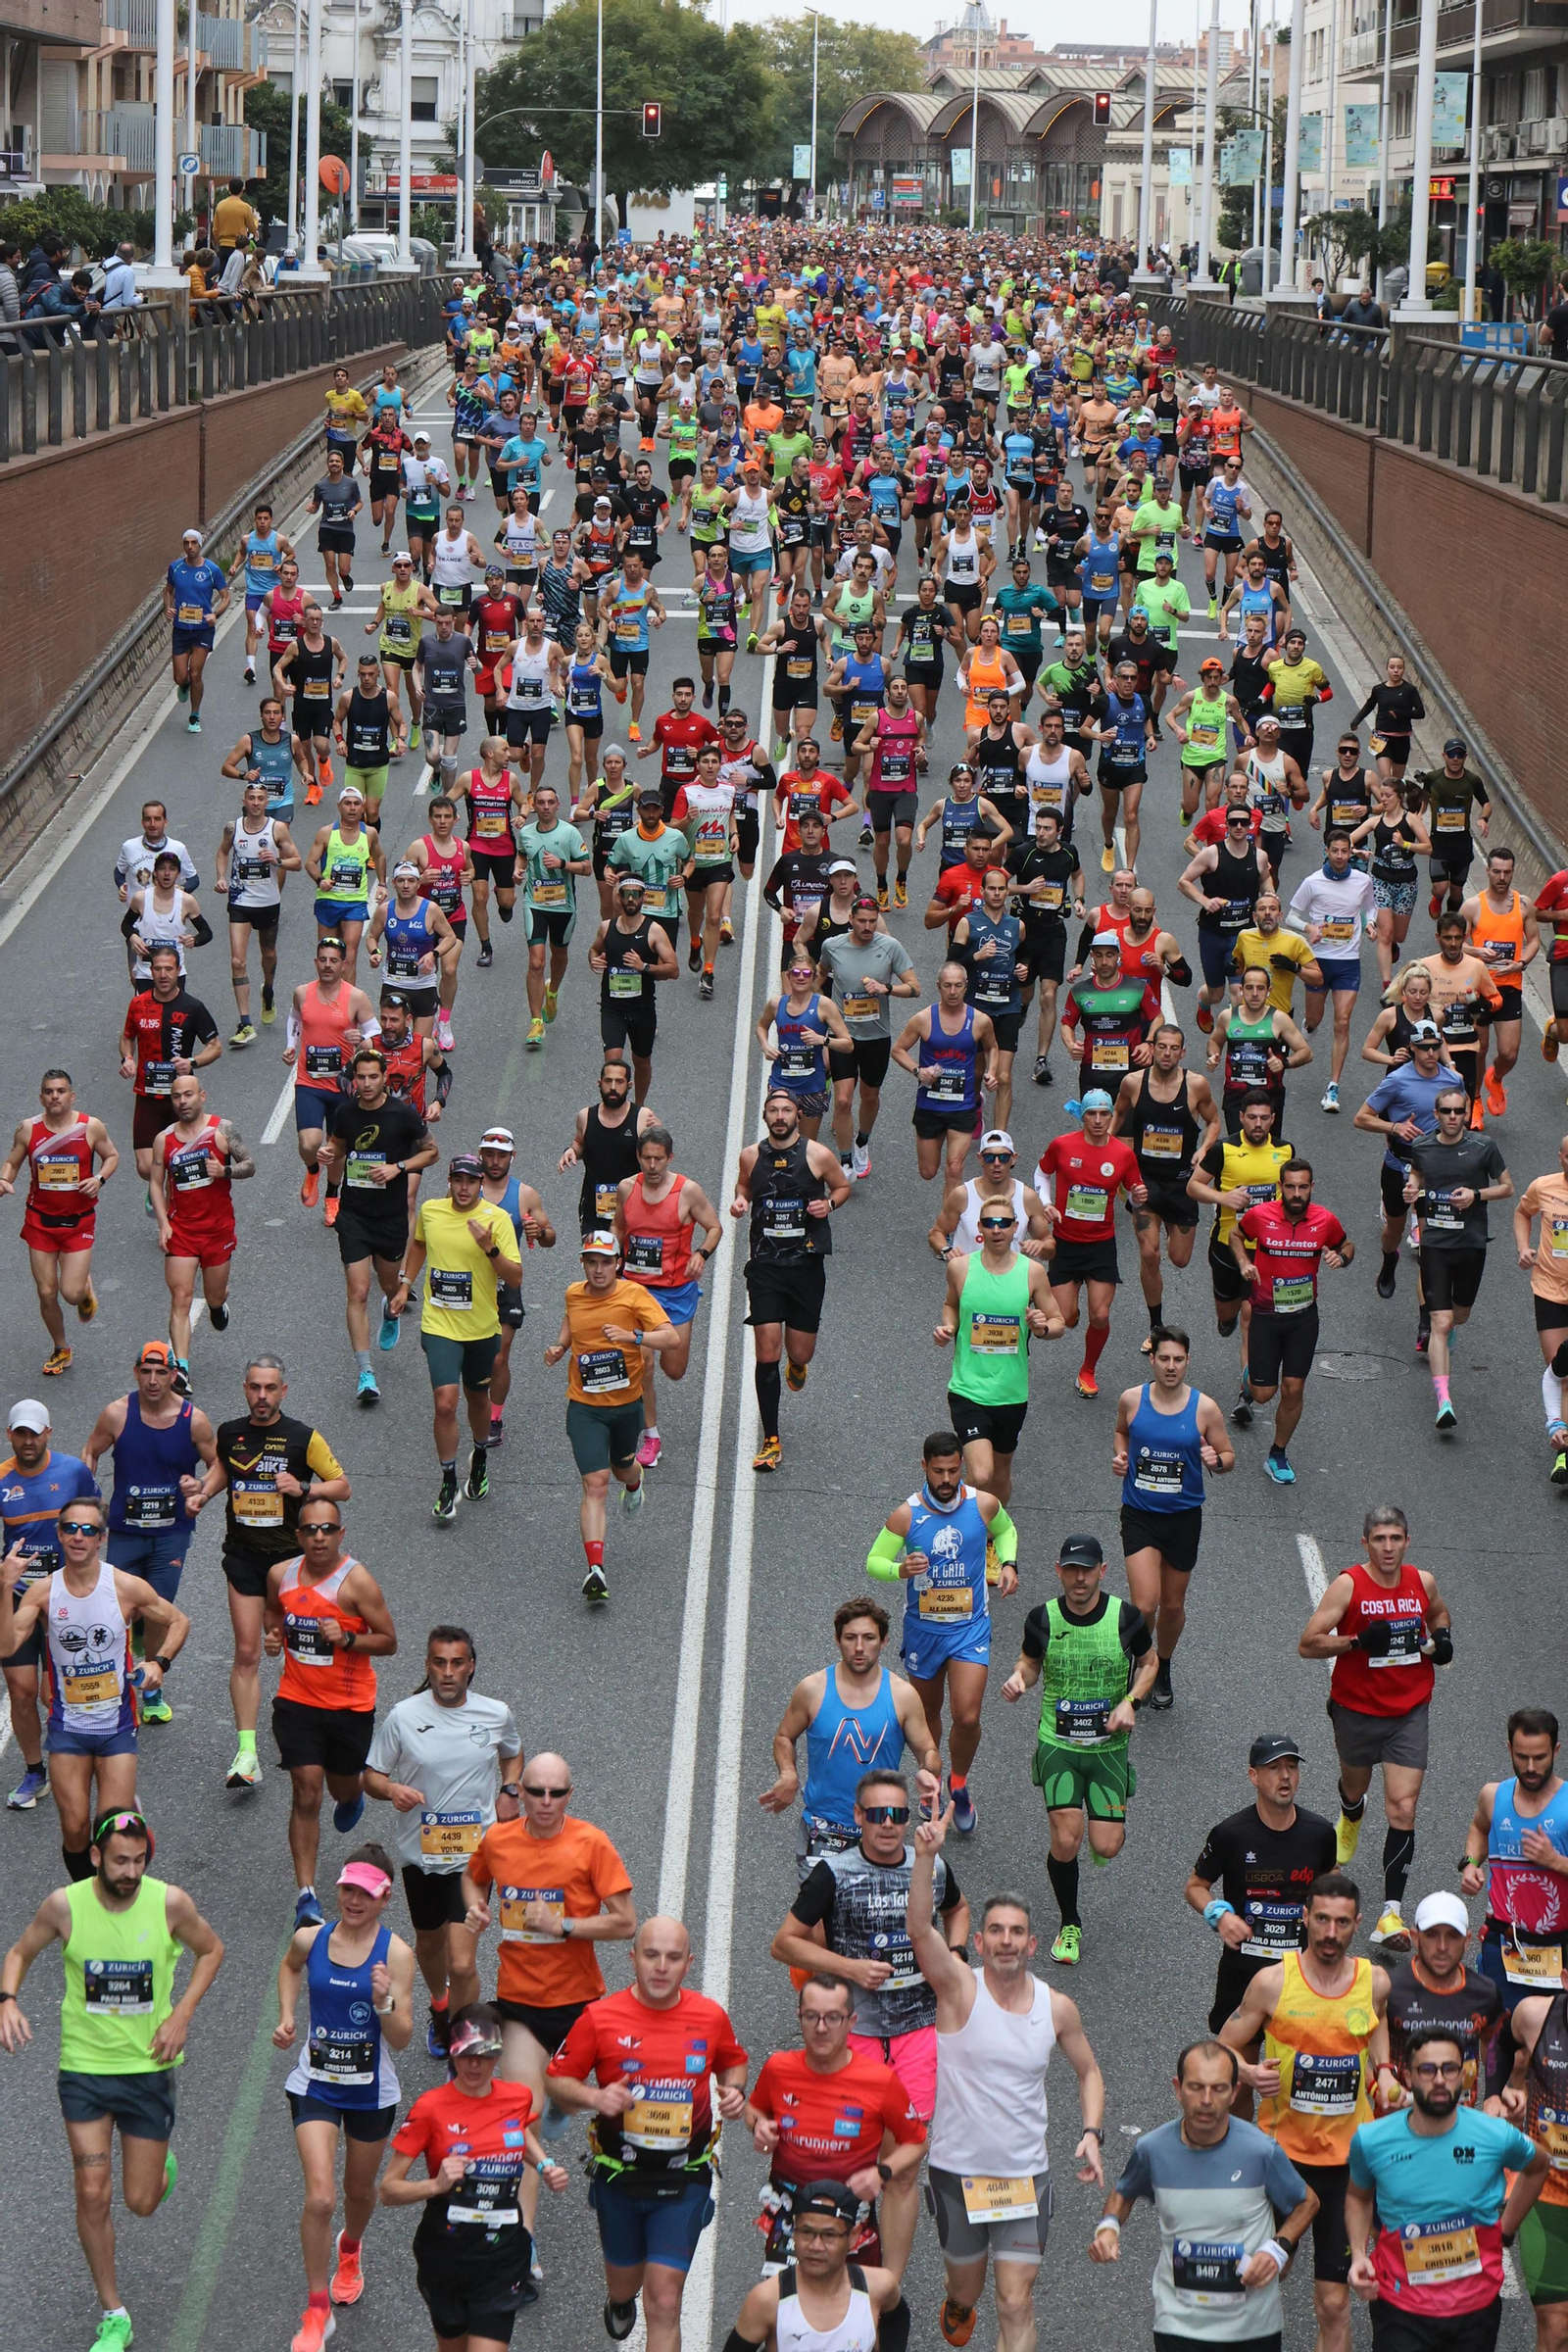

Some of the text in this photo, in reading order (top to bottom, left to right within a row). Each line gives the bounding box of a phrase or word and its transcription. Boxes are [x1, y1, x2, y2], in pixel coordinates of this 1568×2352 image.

[630, 193, 671, 209] MAS
[873, 191, 883, 202] P
[182, 1151, 205, 1162] ZURICH
[775, 1200, 800, 1208] ZURICH
[775, 1212, 789, 1221] 3257
[1265, 1237, 1318, 1249] Los Lentos
[1287, 1276, 1310, 1285] ZURICH
[987, 1329, 1004, 1338] 3938
[591, 1350, 618, 1361] ZURICH
[594, 1365, 611, 1375] 2603
[263, 1455, 289, 1465] TITANES
[1152, 1450, 1180, 1459] ZURICH
[255, 1461, 288, 1475] BIKE
[1151, 1464, 1168, 1473] 2678
[1138, 1473, 1181, 1485] MAURO ANTONIO
[142, 1500, 160, 1510] 3219
[248, 1496, 265, 1506] 4133
[24, 1544, 53, 1552] ZURICH
[937, 1579, 966, 1588] ZURICH
[936, 1593, 955, 1603] 4235
[1361, 1597, 1422, 1615] COSTA RICA
[298, 1617, 319, 1627] ZURIC
[1390, 1619, 1416, 1629] ZURICH
[298, 1634, 315, 1643] 3231
[1387, 1647, 1406, 1656] JORGE
[78, 1662, 109, 1676] ZURICH
[80, 1681, 100, 1690] 5559
[1073, 1701, 1104, 1712] ZURICH
[1073, 1718, 1093, 1728] 3402
[1069, 1729, 1097, 1738] MARCOS
[440, 1813, 474, 1824] ZURICH
[831, 1823, 862, 1834] ZURICH
[441, 1832, 462, 1840] 4439
[826, 1838, 847, 1848] 3367
[440, 1845, 464, 1854] VOLTIO
[1245, 1872, 1285, 1884] LISBOA
[1290, 1866, 1314, 1885] edp
[868, 1891, 889, 1909] Las
[1266, 1905, 1301, 1915] ZURICH
[1264, 1923, 1286, 1935] 3029
[1269, 1936, 1299, 1947] MARTINS
[892, 1950, 914, 1962] 3218
[108, 1961, 146, 1973] ZURICH
[1518, 1967, 1547, 1976] GONZALO
[330, 2030, 368, 2039] ZURICH
[329, 2048, 352, 2059] 3214
[1318, 2056, 1355, 2068] ZURICH
[323, 2063, 358, 2073] CRISTINA
[1314, 2078, 1340, 2089] 2471
[648, 2089, 686, 2101] ZURICH
[1294, 2088, 1354, 2102] ANTÓNIO ROQUE
[644, 2126, 670, 2136] RUBEN
[1452, 2145, 1476, 2159] DX
[479, 2162, 517, 2175] ZURICH
[986, 2180, 1010, 2193] 4048
[989, 2195, 1013, 2208] TOÑIN
[1424, 2218, 1466, 2235] ZURICH
[1195, 2245, 1237, 2257] ZURICH
[1424, 2255, 1463, 2271] CRISTIAN
